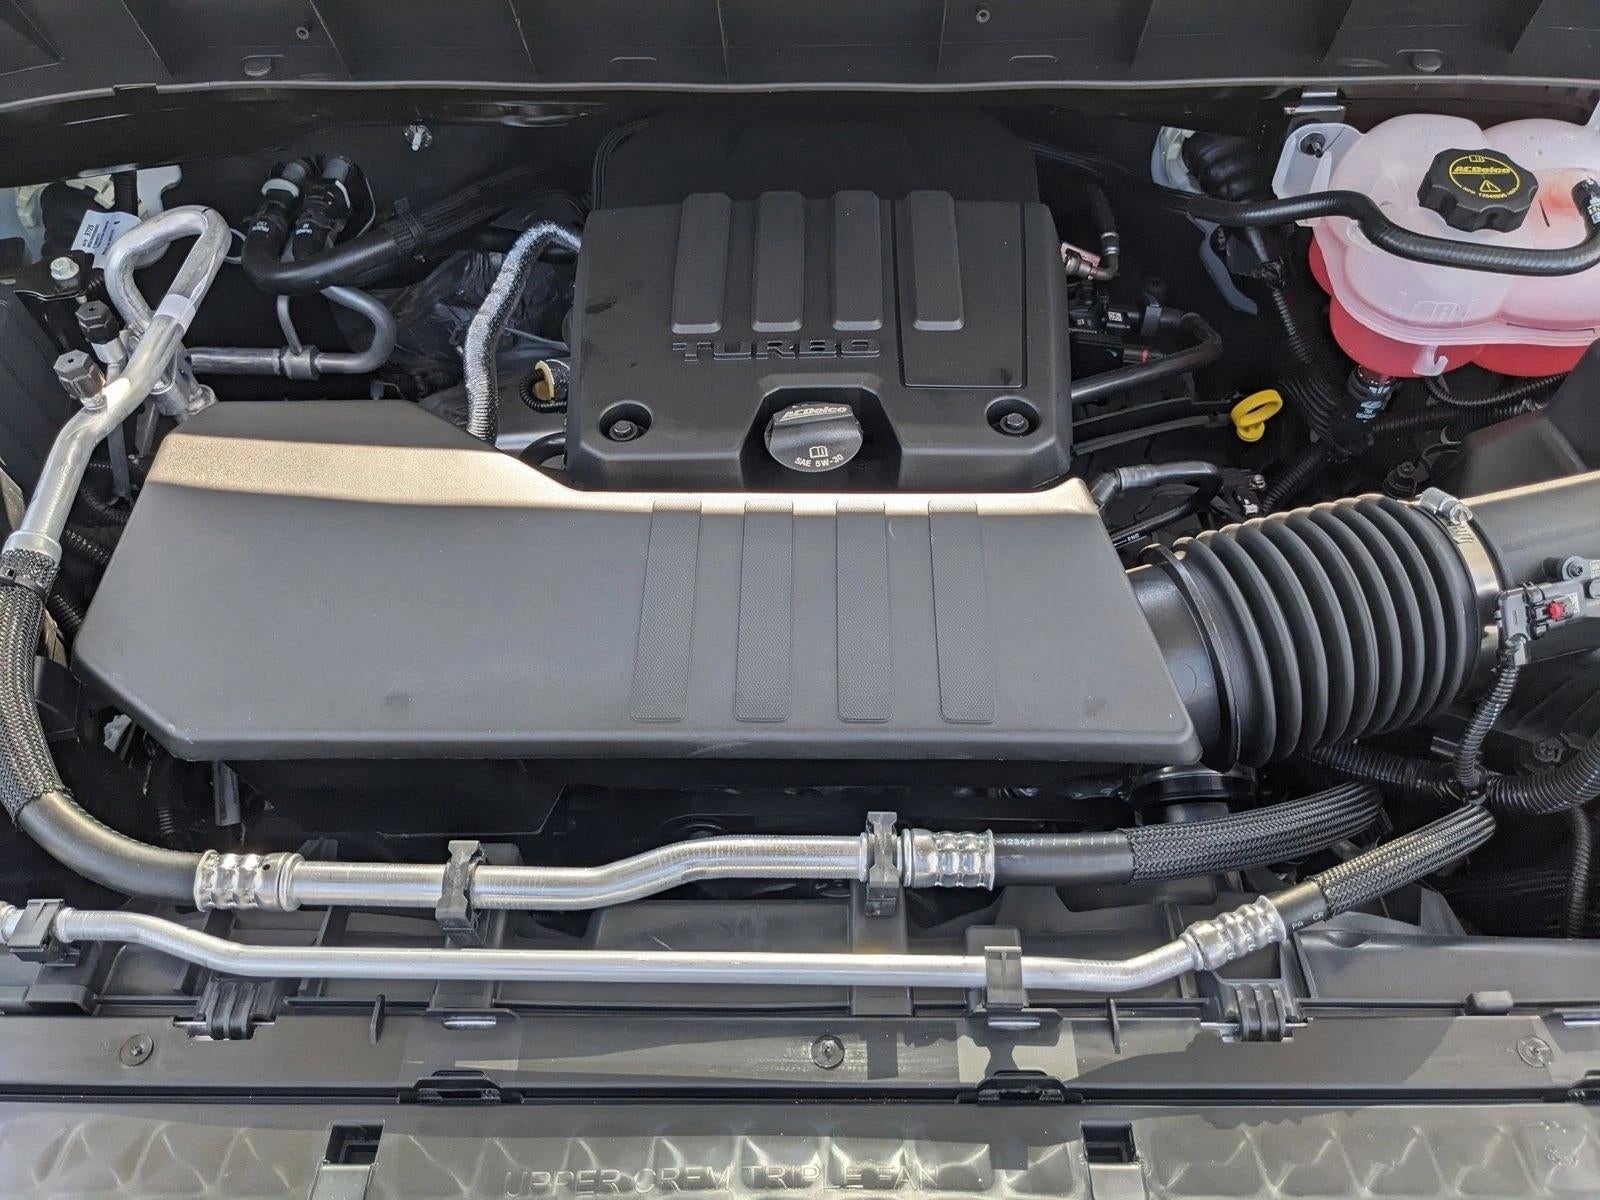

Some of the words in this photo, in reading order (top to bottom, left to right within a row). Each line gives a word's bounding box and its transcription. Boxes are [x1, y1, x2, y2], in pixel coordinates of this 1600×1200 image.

[672, 339, 880, 362] TURBO
[780, 407, 848, 420] ACDelco
[794, 457, 811, 467] SAE
[815, 453, 844, 468] 5W-30
[504, 1168, 620, 1197] UPPER
[741, 1165, 864, 1190] TRIPLE
[877, 1165, 939, 1191] FAN
